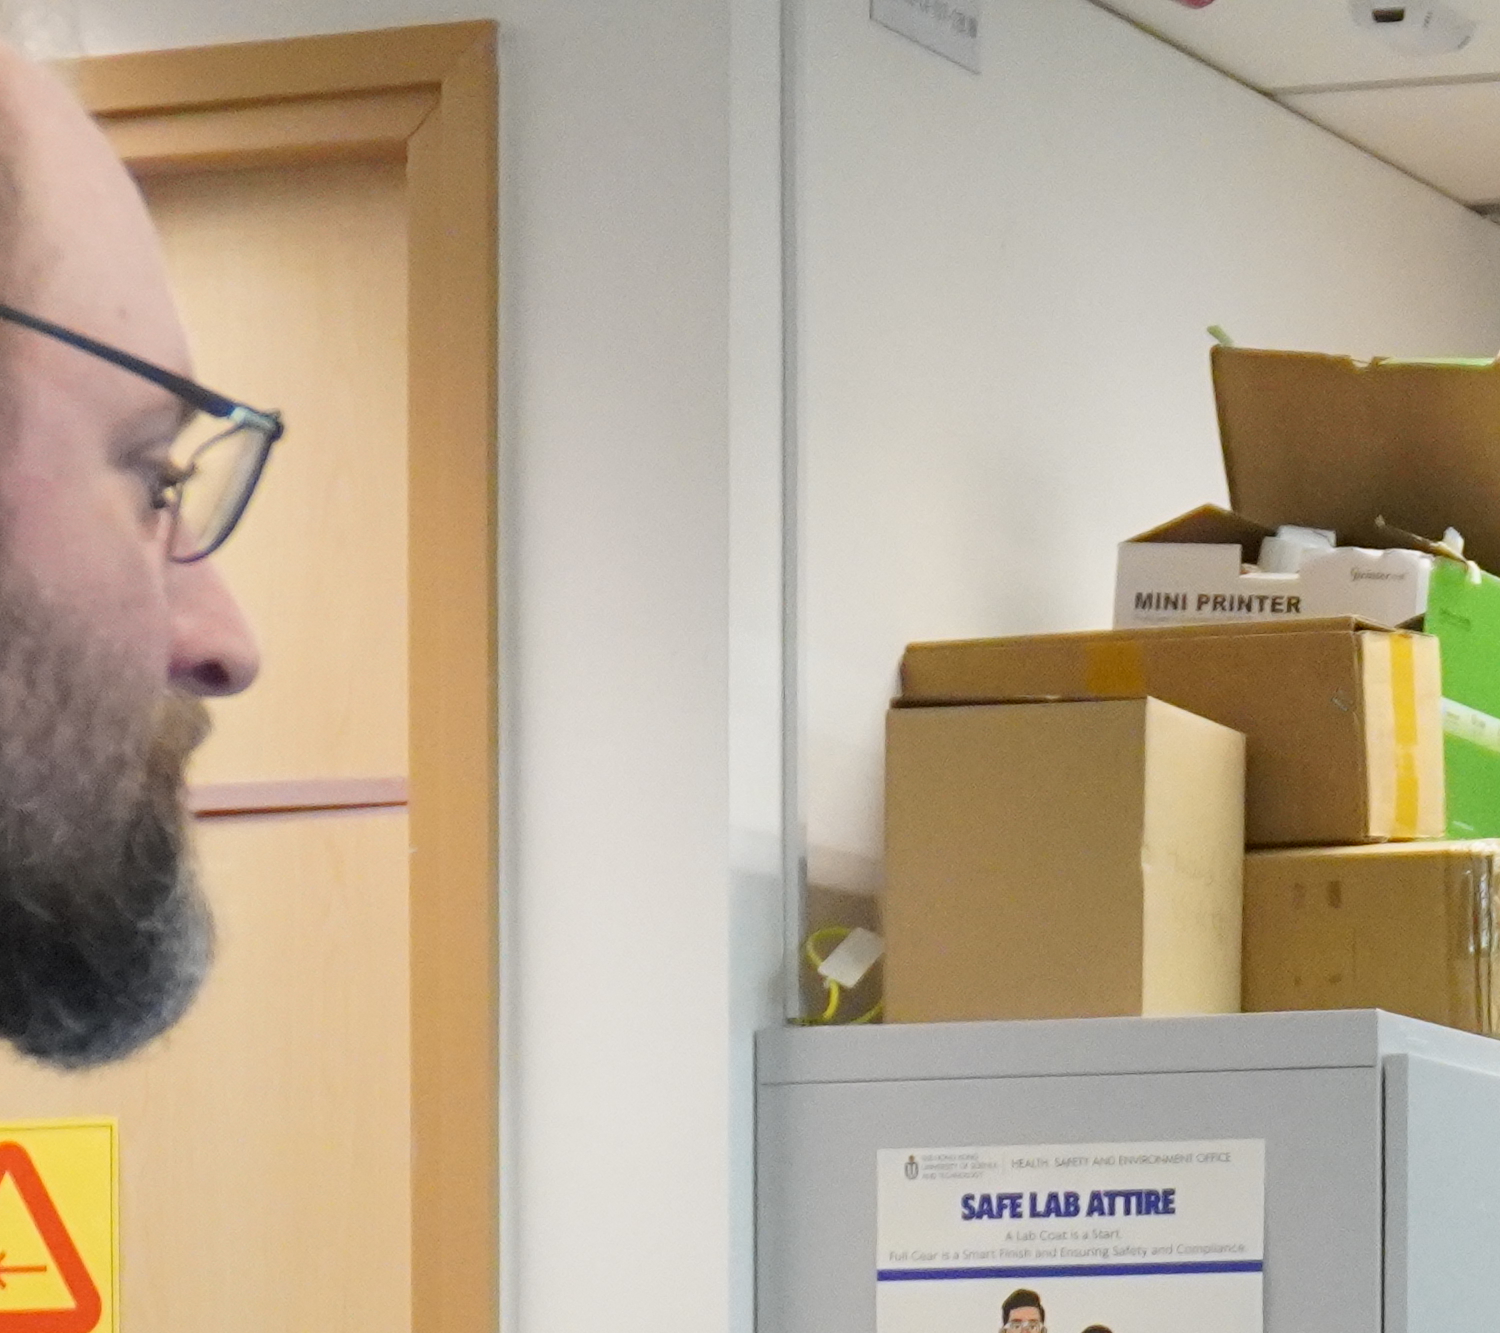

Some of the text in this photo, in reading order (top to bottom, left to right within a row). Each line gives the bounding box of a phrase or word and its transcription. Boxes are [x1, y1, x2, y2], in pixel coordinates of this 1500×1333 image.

[1134, 592, 1301, 614] MINI PRINTER
[961, 1188, 1176, 1221] SAFE LAB ATTIRE
[1005, 1231, 1012, 1240] A
[1016, 1231, 1036, 1240] Lab
[1039, 1230, 1068, 1240] Coat
[1070, 1230, 1078, 1239] is
[889, 1251, 908, 1261] Full
[962, 1249, 996, 1260] Smart
[1000, 1248, 1031, 1259] Finish
[1035, 1248, 1057, 1258] and
[1112, 1245, 1147, 1258] Safety
[1151, 1244, 1173, 1255] and
